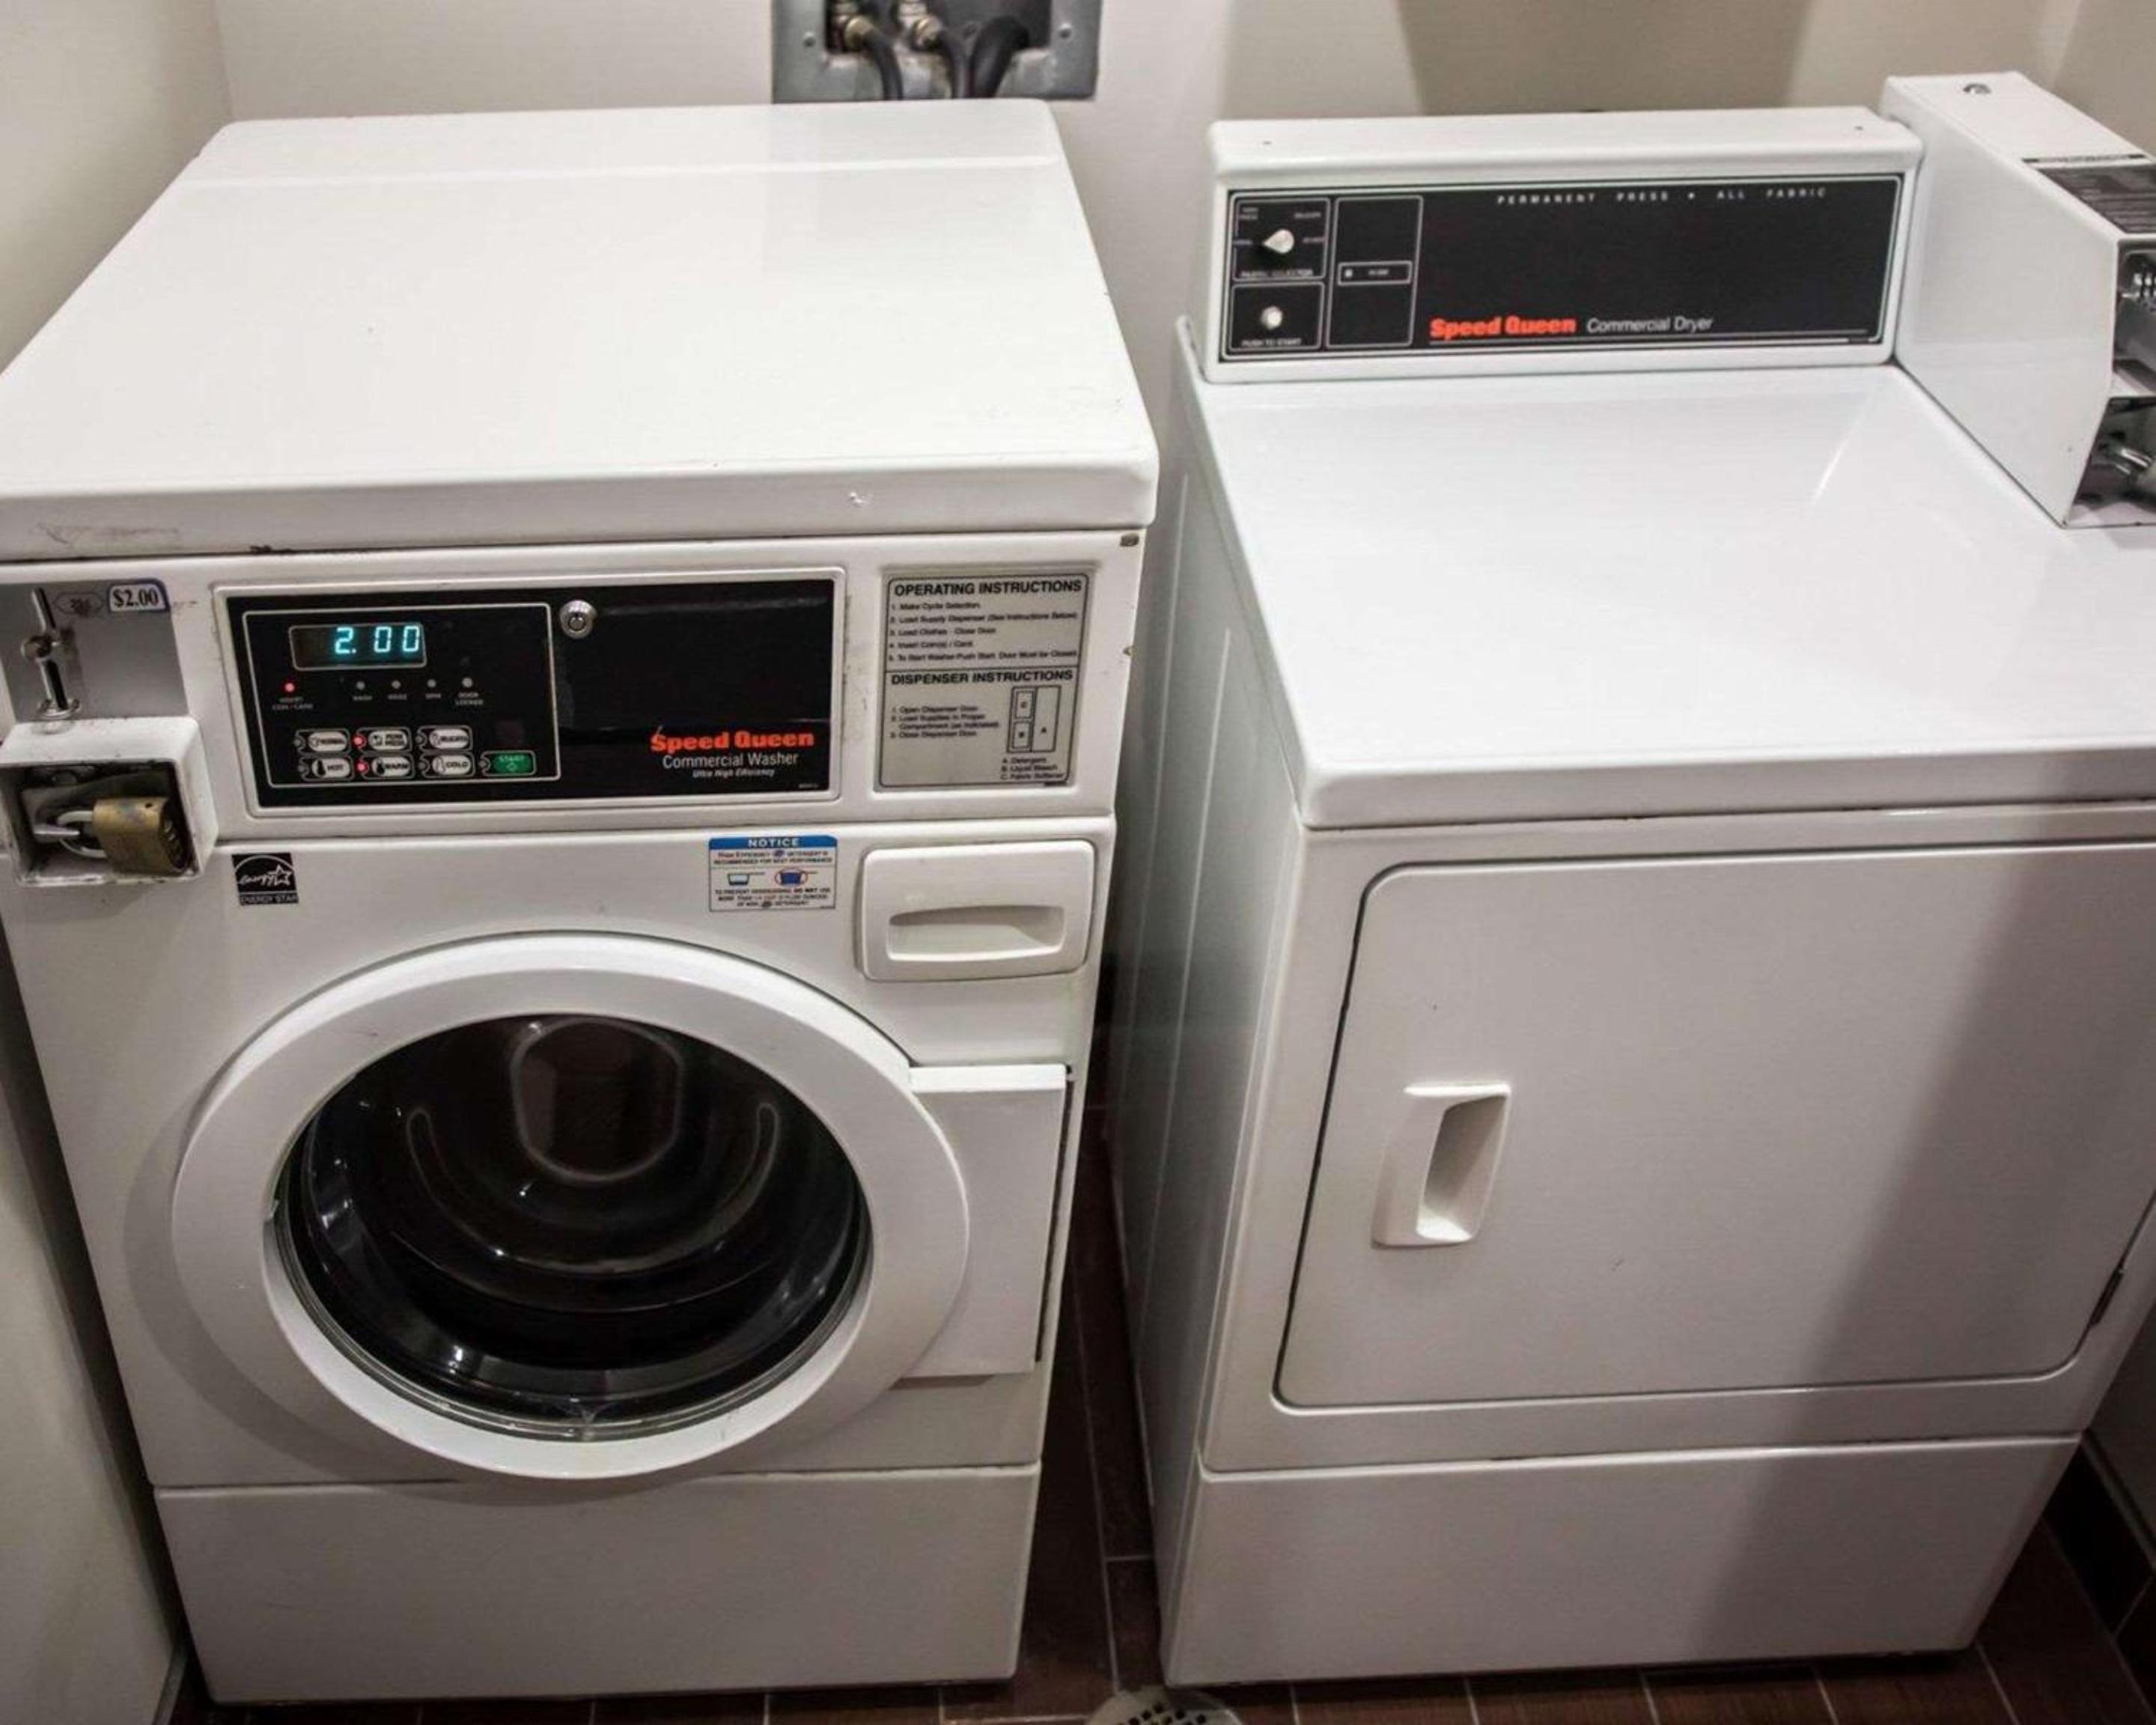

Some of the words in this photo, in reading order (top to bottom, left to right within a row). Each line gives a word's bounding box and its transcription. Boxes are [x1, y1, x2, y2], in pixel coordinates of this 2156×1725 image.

[1497, 193, 1595, 204] PERMANENT
[1430, 317, 1502, 341] Speed
[1505, 315, 1577, 335] Queen
[1587, 317, 1670, 334] Commercial
[1674, 315, 1714, 334] Dryer
[894, 582, 975, 597] OPERATING
[978, 579, 1082, 594] INSTRUCTIONS
[112, 588, 159, 608] $2.00
[335, 625, 421, 654] 2.00
[891, 672, 969, 685] DISPENSER
[972, 669, 1074, 683] INSTRUCTIONS
[651, 731, 729, 753] Speed
[734, 730, 814, 749] Queen
[662, 752, 744, 769] Commercial
[747, 751, 800, 766] Washer
[748, 838, 800, 848] NOTICE
